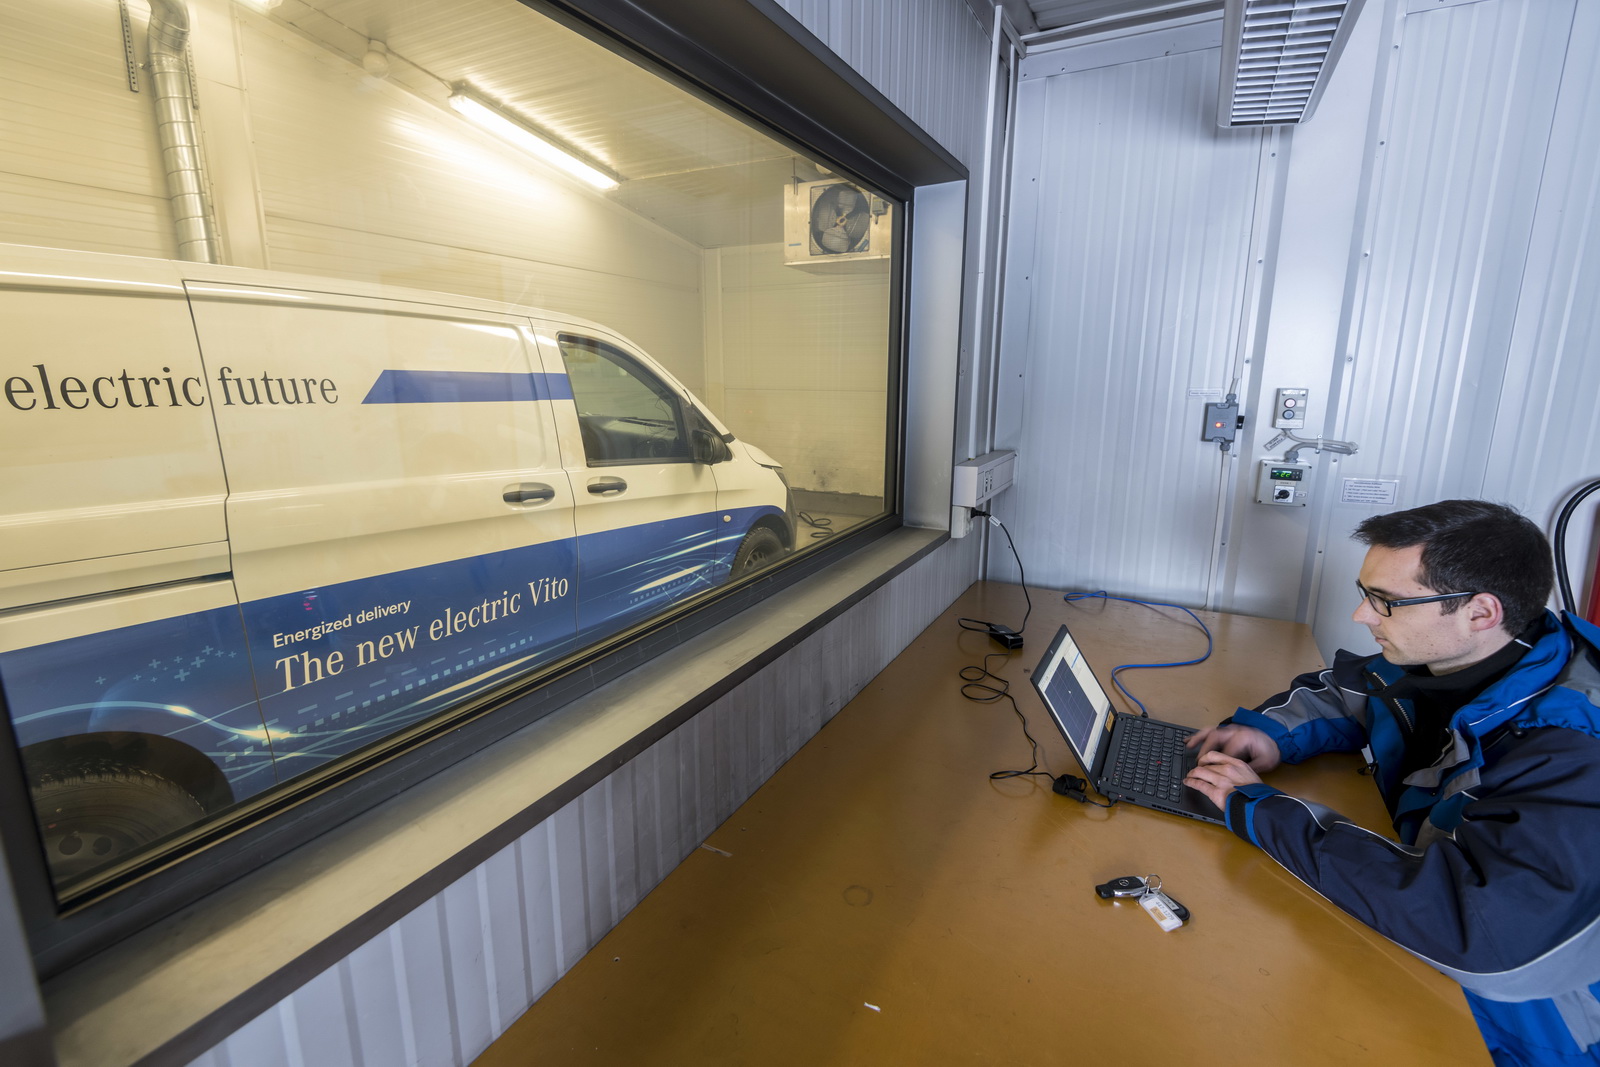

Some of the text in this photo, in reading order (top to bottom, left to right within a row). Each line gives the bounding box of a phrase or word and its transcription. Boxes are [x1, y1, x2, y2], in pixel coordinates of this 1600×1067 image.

[4, 363, 339, 411] electric future
[272, 600, 411, 648] Energized delivery
[275, 577, 569, 693] The new electric Vito
